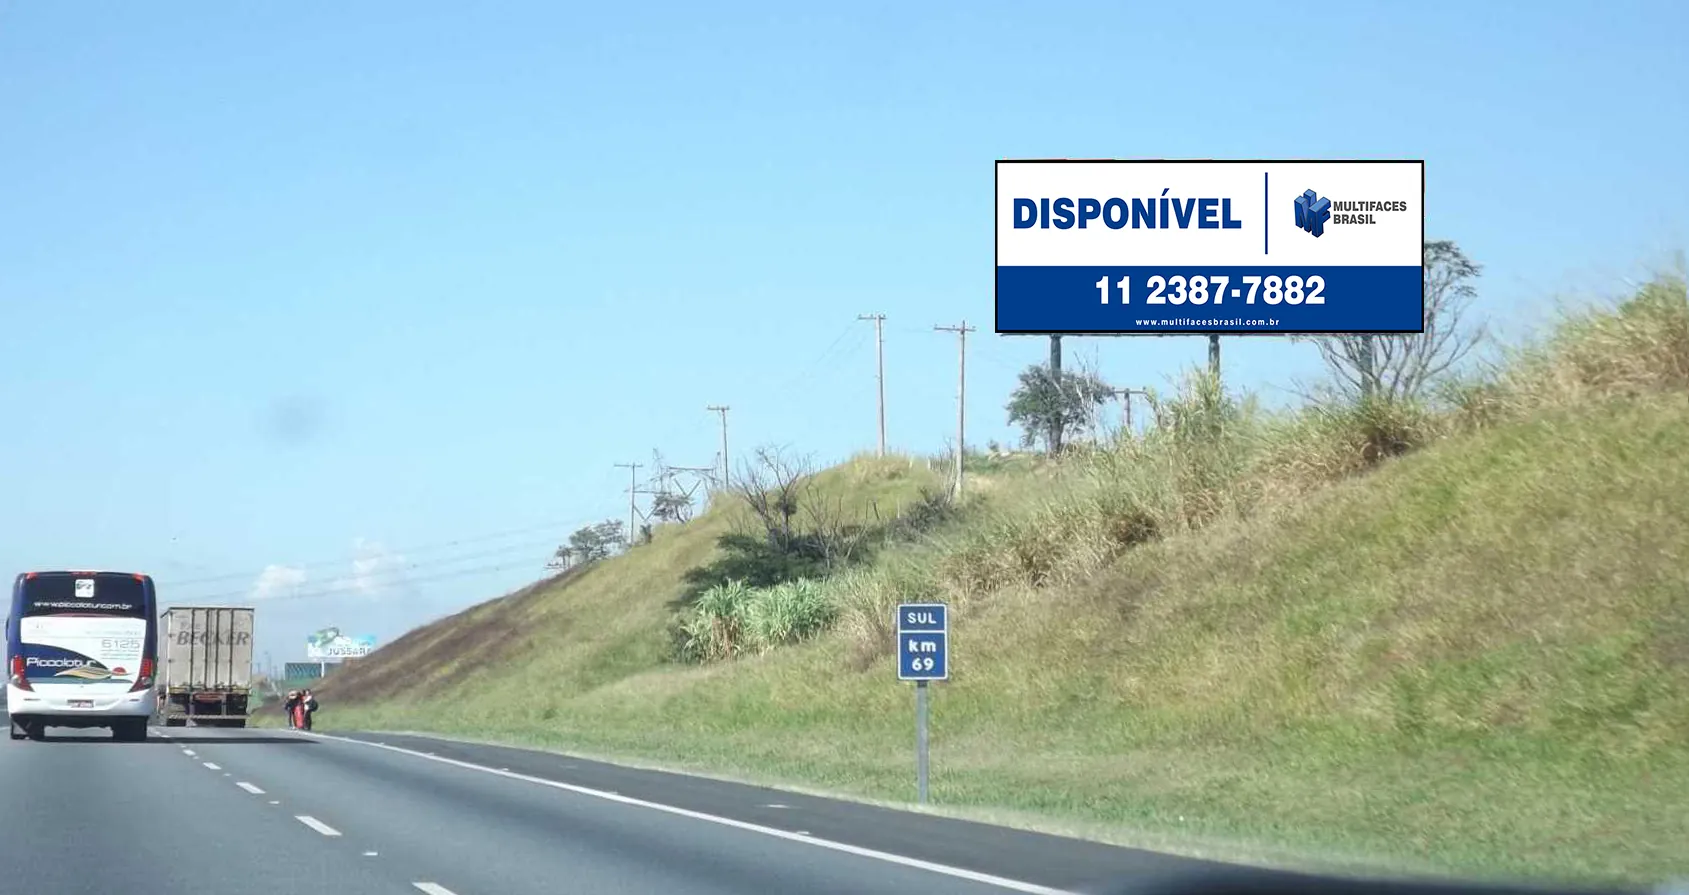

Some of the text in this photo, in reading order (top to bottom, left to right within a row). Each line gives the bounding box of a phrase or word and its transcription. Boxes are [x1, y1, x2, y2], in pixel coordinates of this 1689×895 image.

[1013, 188, 1242, 230] DISPONÍVEL
[1333, 201, 1407, 212] MULTIFACES
[1333, 214, 1376, 225] BRASIL
[1095, 275, 1326, 305] 11 2387-7882
[1135, 318, 1280, 326] www.multifacesbrasil.com.br
[907, 612, 936, 624] SUL
[101, 639, 140, 649] 6125
[177, 631, 250, 646] BECKER
[908, 639, 936, 653] km
[26, 656, 97, 668] Piccolotur
[912, 658, 934, 672] 69
